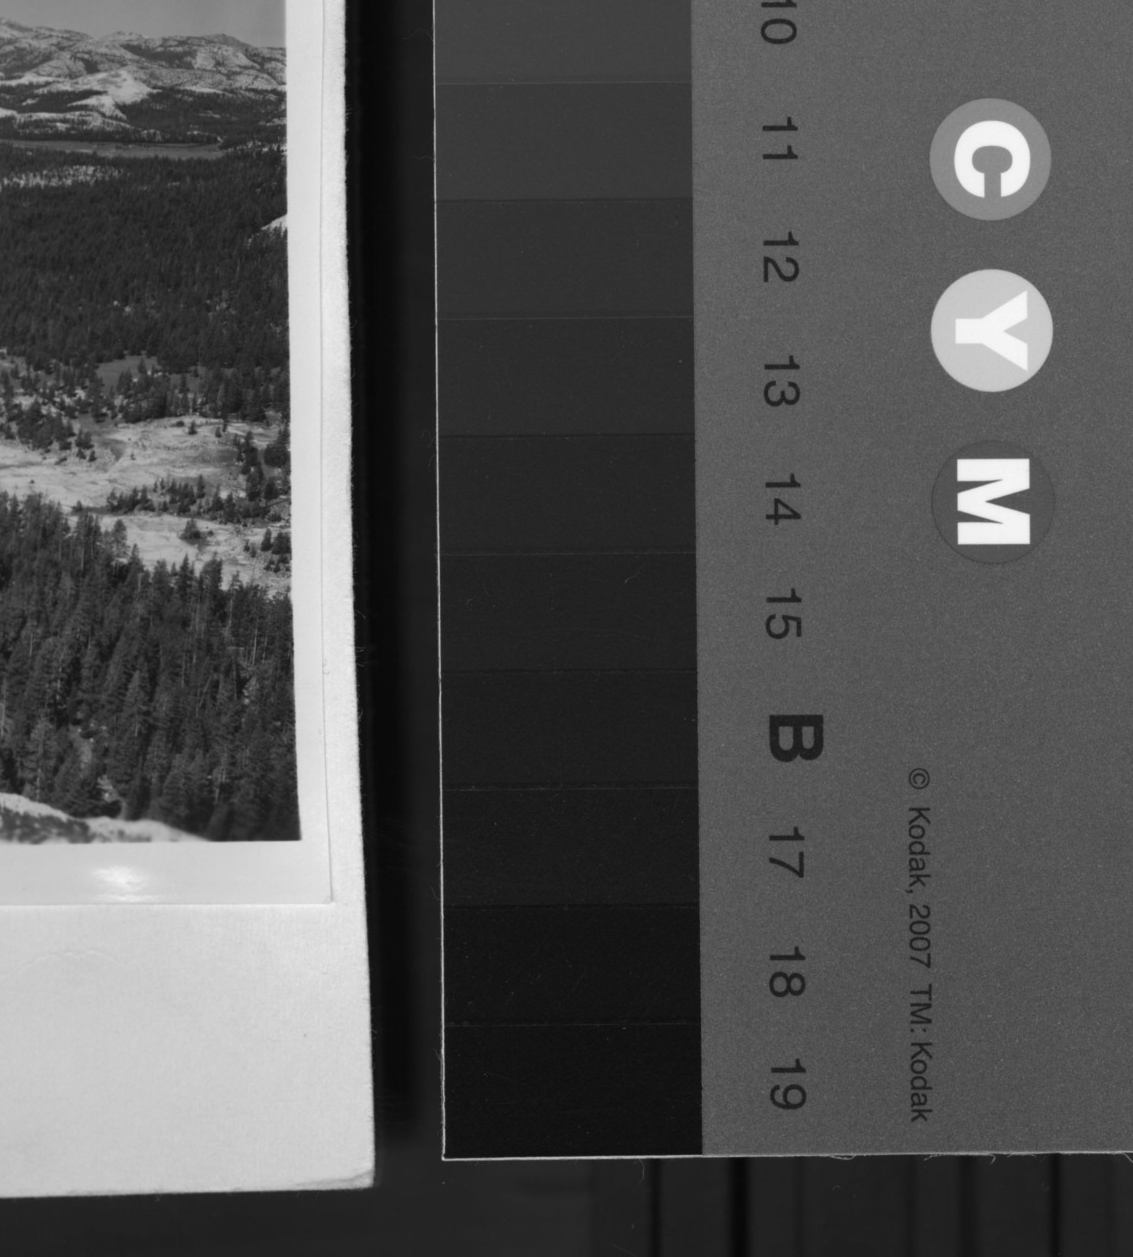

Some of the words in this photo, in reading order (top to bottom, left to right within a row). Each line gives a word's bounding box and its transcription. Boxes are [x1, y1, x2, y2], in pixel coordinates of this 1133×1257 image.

[762, 117, 798, 160] 11
[954, 120, 1030, 197] C
[763, 231, 800, 282] 12
[955, 291, 1028, 371] Y
[763, 355, 801, 407] 13
[765, 473, 801, 525] 14
[957, 458, 1030, 545] M
[765, 588, 802, 640] 15
[769, 714, 824, 762] B
[769, 827, 805, 878] 17
[905, 807, 931, 894] Kodak,
[909, 904, 931, 968] 2007
[769, 946, 806, 998] 18
[910, 984, 933, 1032] TM:
[770, 1058, 807, 1110] 19
[910, 1042, 933, 1122] Kodak
